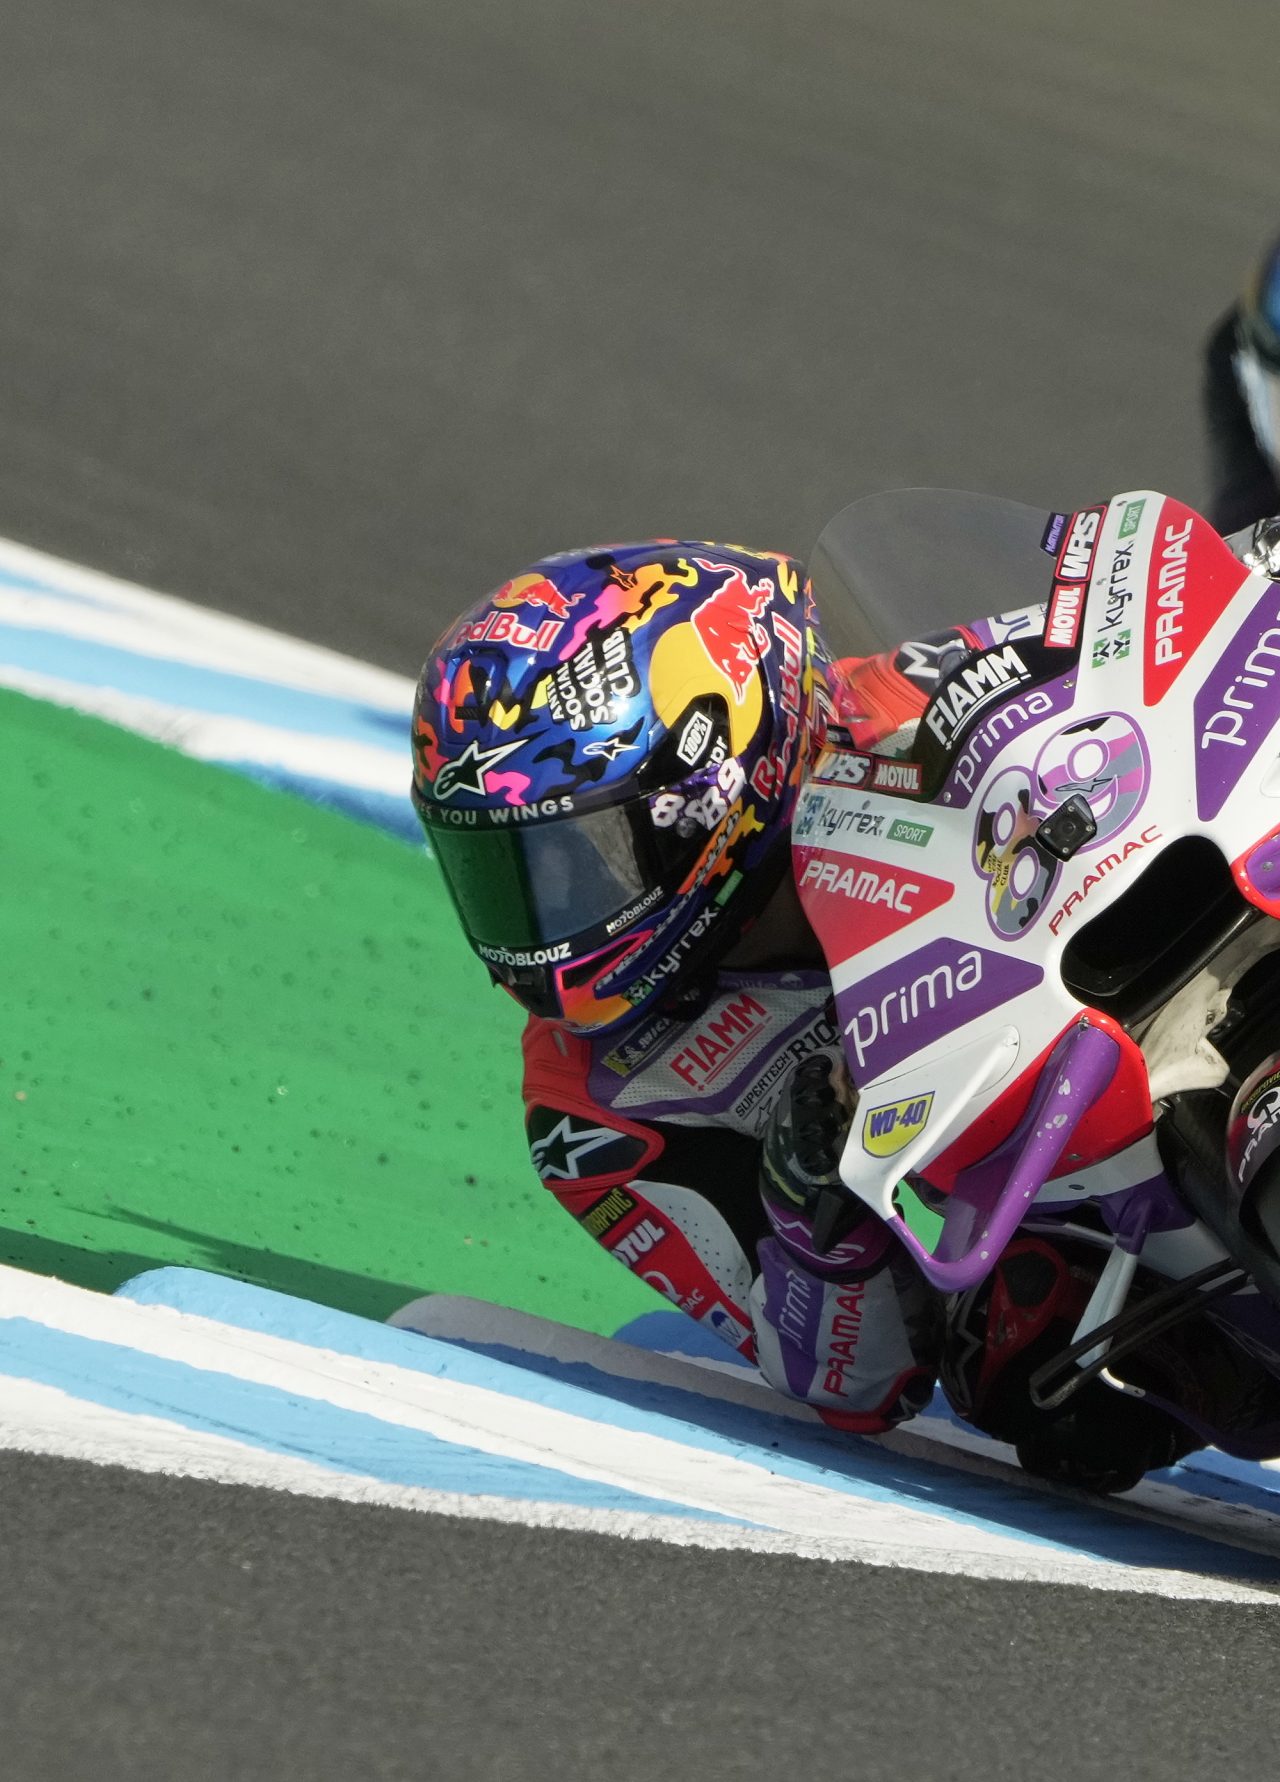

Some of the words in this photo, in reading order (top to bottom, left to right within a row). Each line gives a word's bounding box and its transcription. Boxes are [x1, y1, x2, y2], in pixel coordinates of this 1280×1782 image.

[1050, 587, 1081, 645] MOTUL
[1155, 518, 1194, 666] PRAMAC
[485, 612, 565, 652] Bull
[602, 629, 634, 698] CLUB
[546, 681, 565, 720] ANTI
[556, 662, 586, 731] SOCIAL
[573, 641, 609, 723] SOCIAL
[926, 645, 1029, 745] FIAMM
[684, 716, 708, 758] 100%
[954, 692, 1054, 794] prima
[874, 763, 920, 791] MOTUL
[440, 808, 478, 826] YOU
[488, 796, 575, 825] WINGS
[893, 823, 927, 843] SPORT
[972, 711, 1151, 942] 89
[800, 860, 920, 914] PRAMAC
[1049, 825, 1163, 937] PRAMAC
[478, 942, 572, 967] MOTOBLOUZ
[668, 992, 767, 1087] FIAMM
[845, 951, 982, 1067] prima
[735, 1051, 791, 1118] SUPERTECH
[869, 1099, 927, 1138] WD-40
